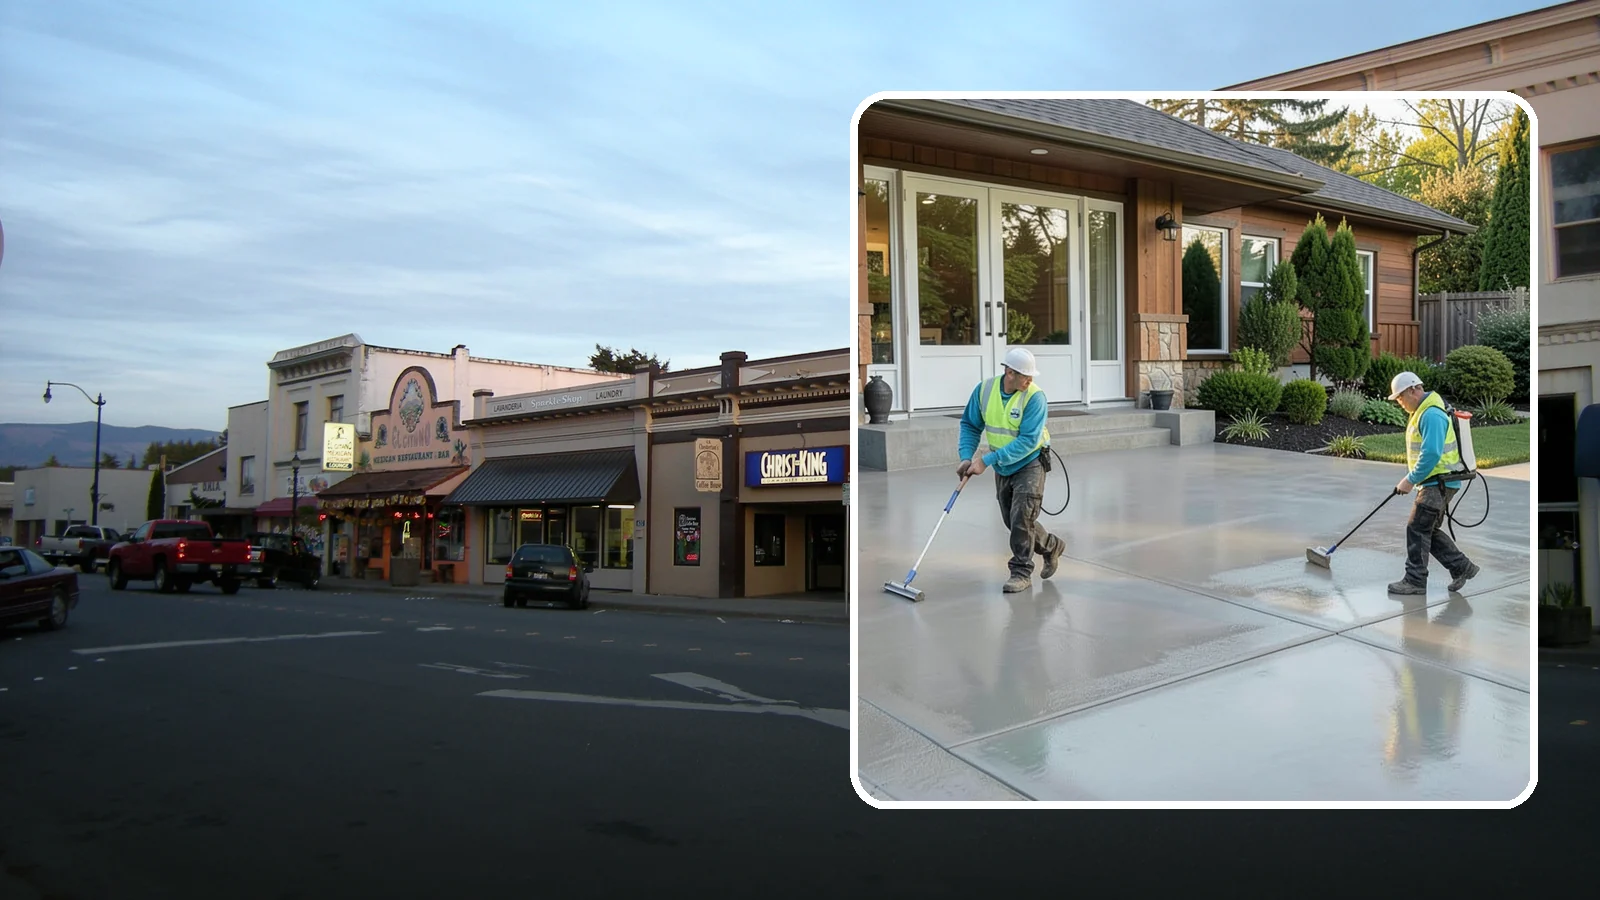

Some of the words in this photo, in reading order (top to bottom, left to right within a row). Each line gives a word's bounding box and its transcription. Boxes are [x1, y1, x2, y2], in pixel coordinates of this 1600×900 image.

[494, 402, 523, 412] LAVANDERIA
[531, 397, 561, 409] Sparkle
[562, 395, 583, 404] Shop
[595, 389, 624, 400] LAUNDRY
[374, 455, 396, 463] MEXICAN
[397, 451, 433, 461] RESTAURANT
[438, 450, 450, 459] BAR
[799, 450, 827, 476] KING
